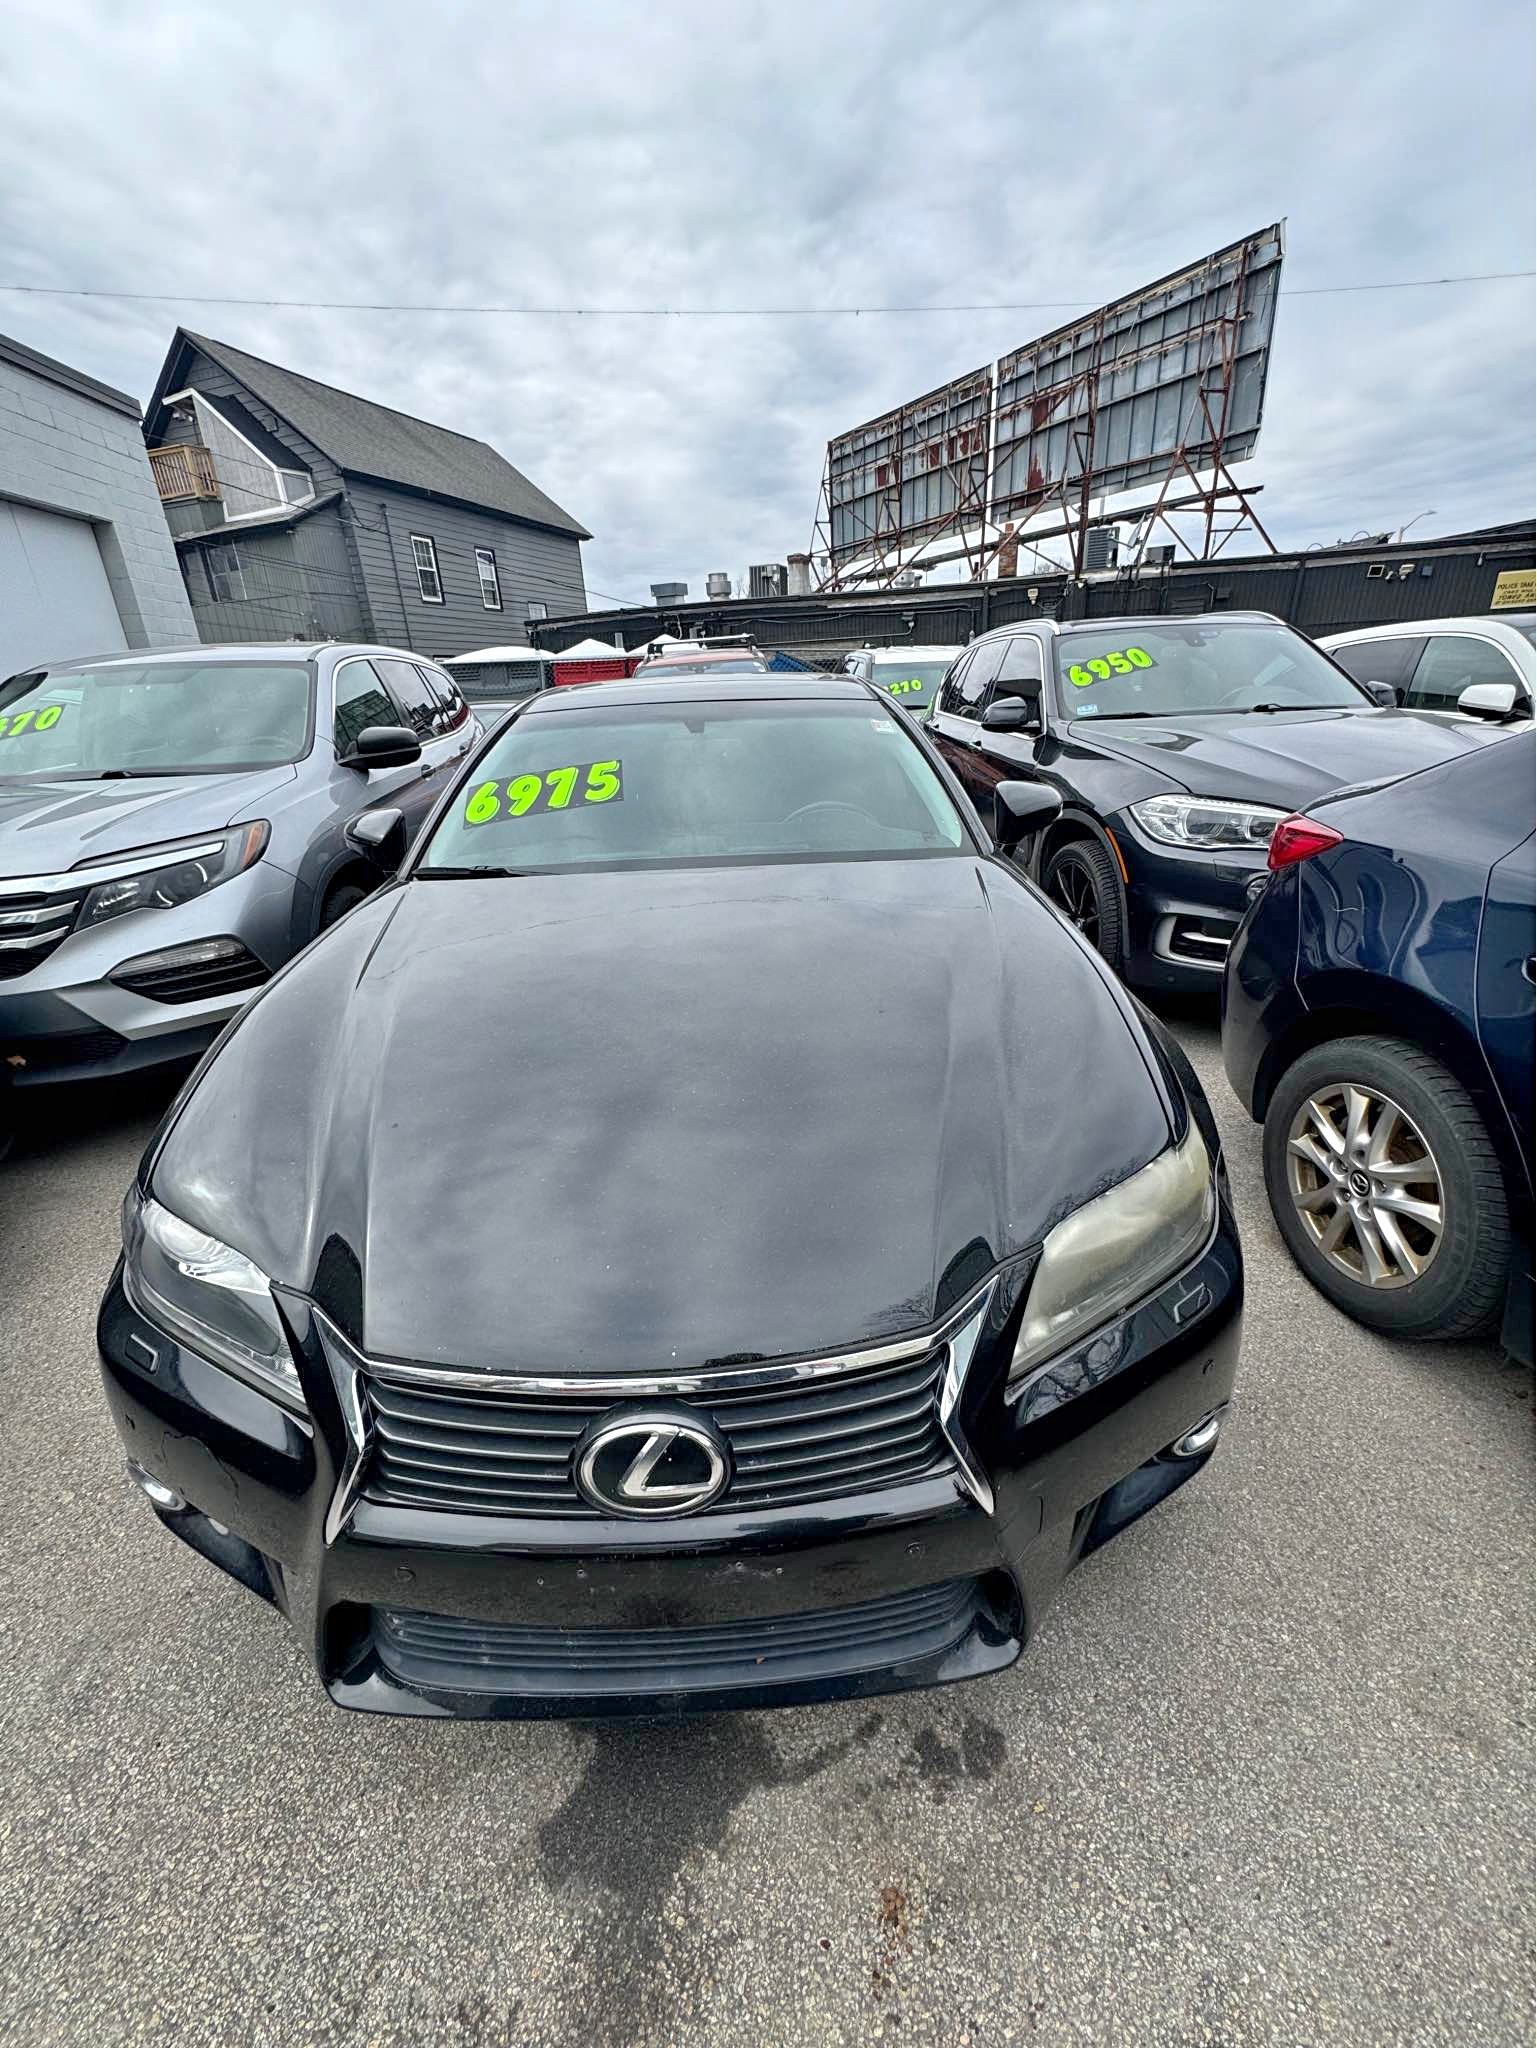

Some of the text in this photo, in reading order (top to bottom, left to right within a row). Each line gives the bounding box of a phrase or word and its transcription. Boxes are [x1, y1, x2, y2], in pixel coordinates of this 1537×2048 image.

[1069, 647, 1153, 687] 6950
[883, 679, 922, 696] 270
[465, 760, 620, 824] 6975
